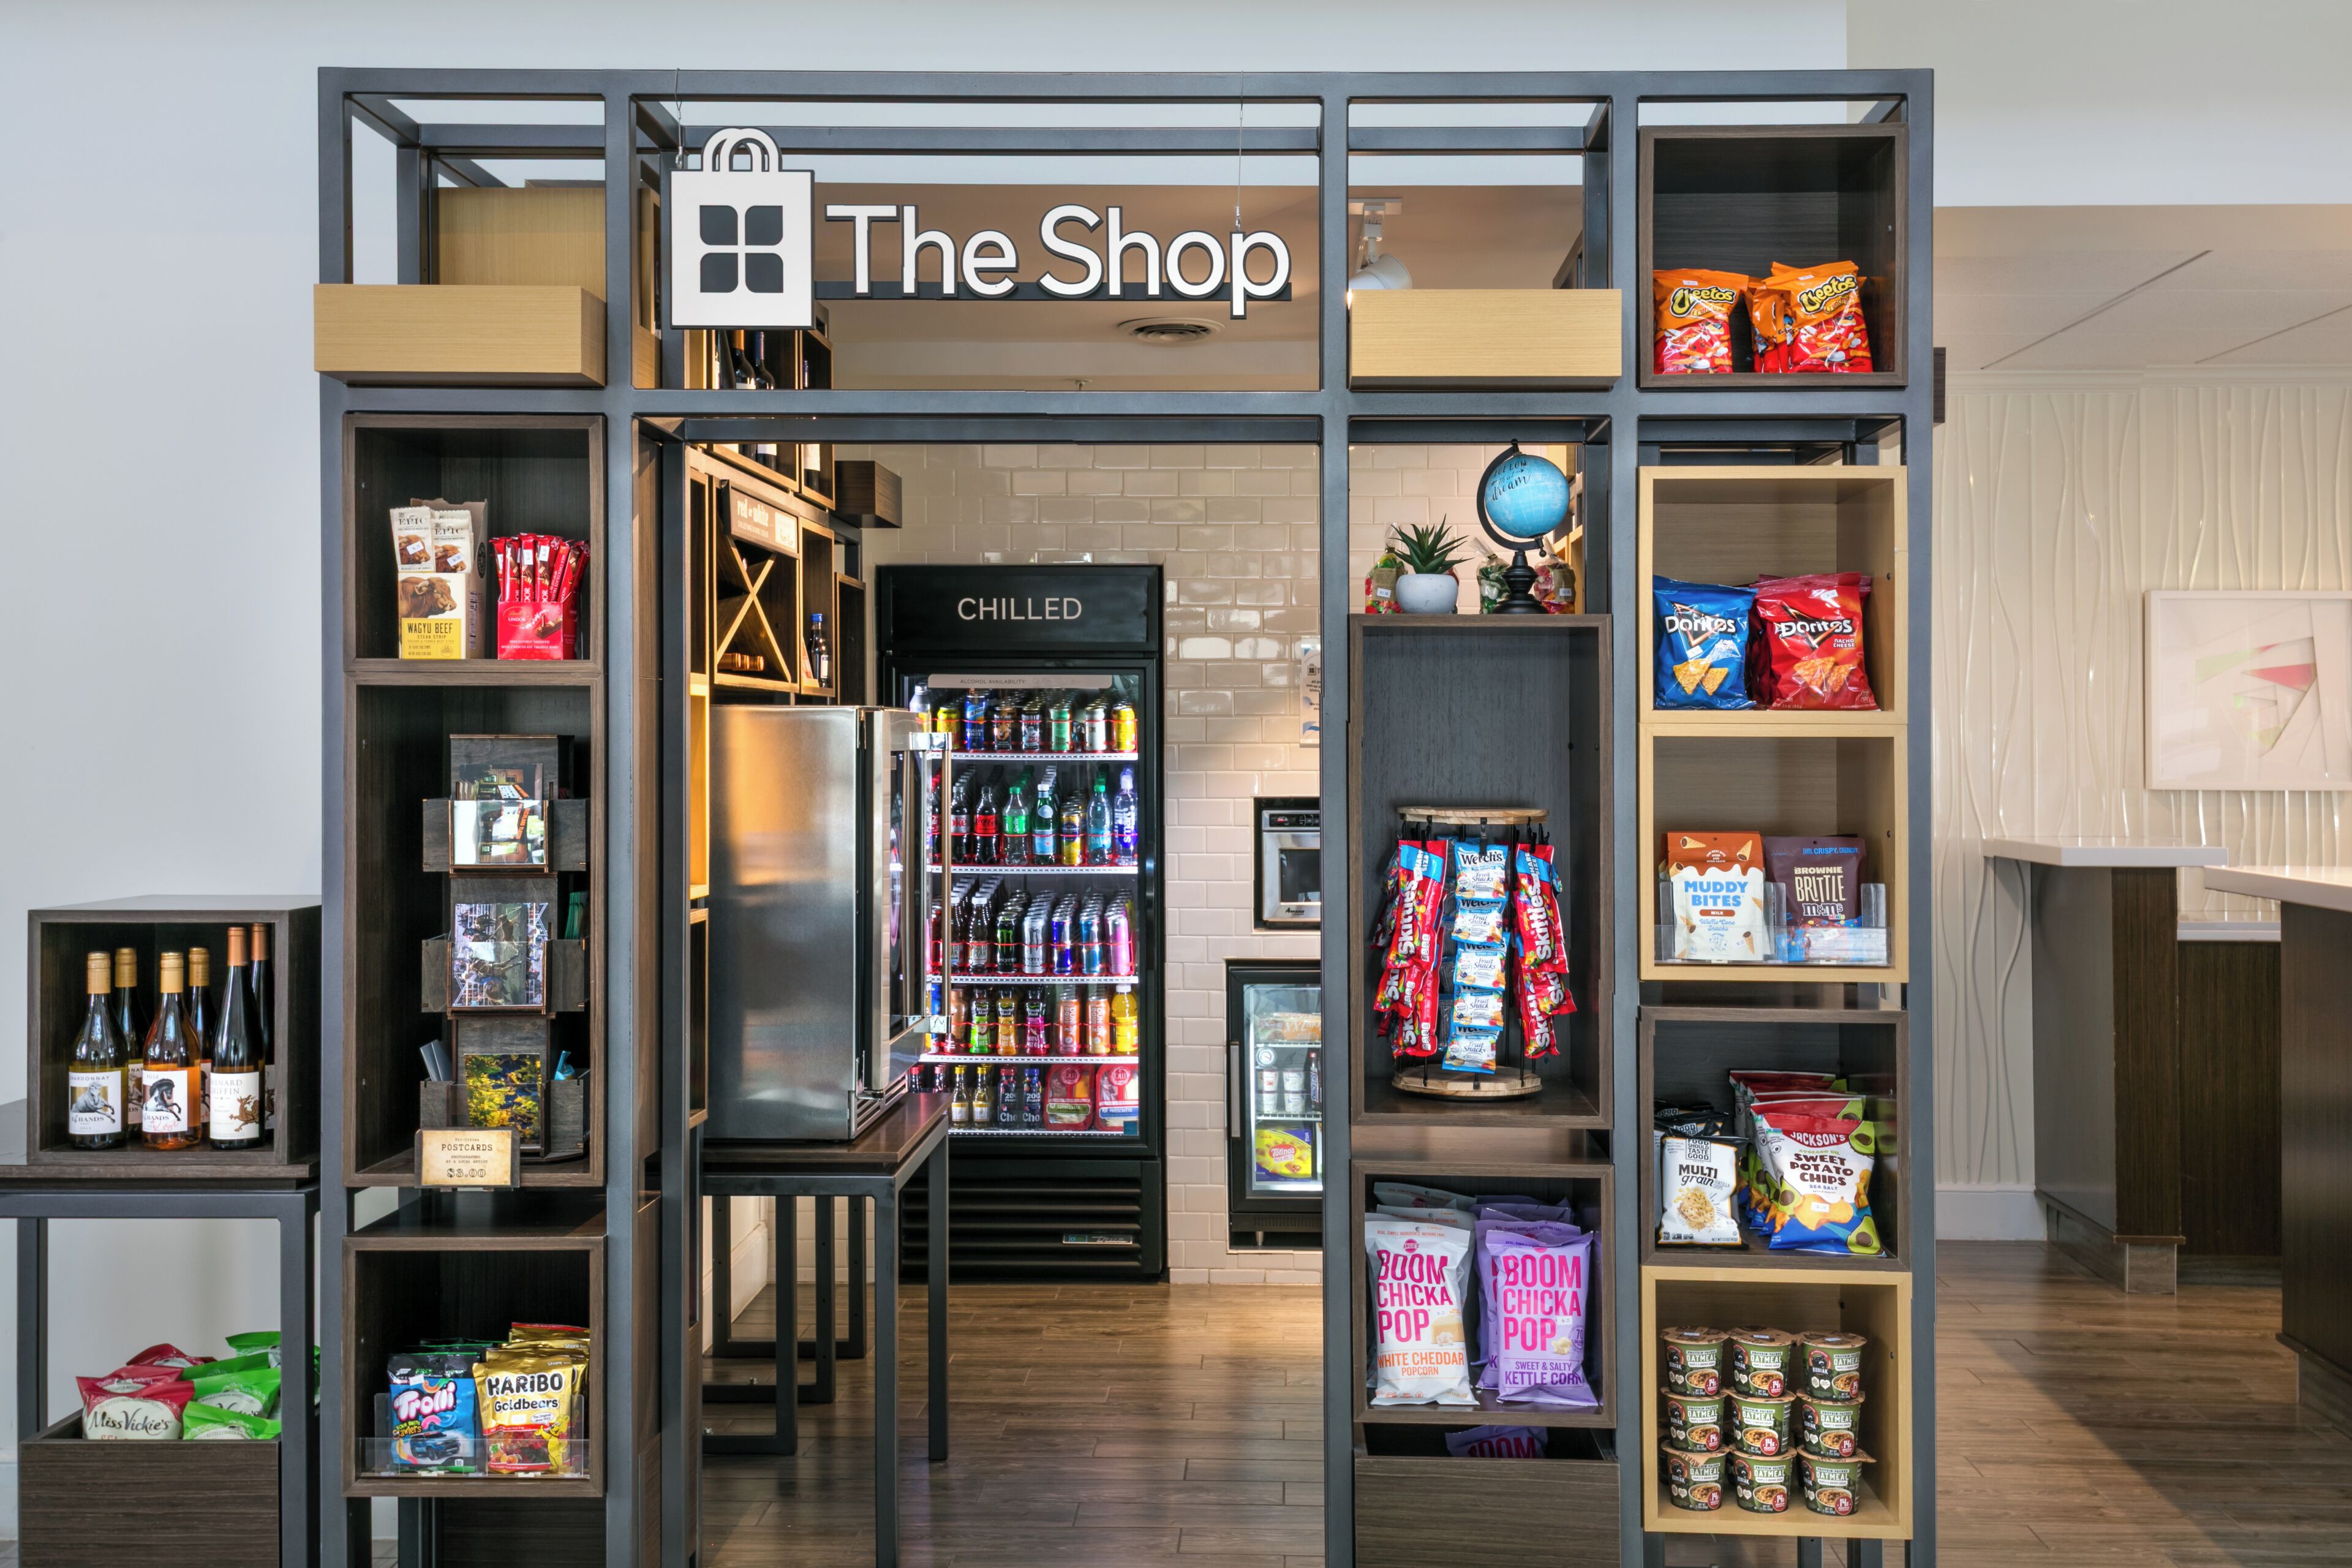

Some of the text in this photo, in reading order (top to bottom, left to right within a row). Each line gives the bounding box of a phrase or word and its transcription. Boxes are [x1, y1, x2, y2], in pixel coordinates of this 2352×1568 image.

[824, 203, 1292, 320] The Shop
[1672, 287, 1736, 317] Cheetos
[1800, 274, 1858, 314] Cheetos
[1823, 294, 1852, 314] Crunchy
[1492, 475, 1531, 500] dream
[737, 498, 769, 527] red white
[957, 597, 1082, 620] CHILLED
[407, 622, 453, 633] WAGYU BEEF
[1665, 615, 1736, 635] Doritos
[1780, 619, 1854, 638] Doritos
[951, 817, 967, 826] oke
[1415, 849, 1425, 869] HARE
[1794, 866, 1843, 875] BROWNIE
[1684, 881, 1749, 893] MUDDY
[1795, 875, 1845, 903] BRITTLE
[1692, 894, 1741, 907] BITES
[1528, 884, 1553, 960] Skittles
[1790, 1131, 1846, 1147] JACKSON'S
[1271, 1148, 1295, 1157] Totino's
[1794, 1153, 1846, 1166] SWEET
[447, 1167, 486, 1178] $3.00
[1679, 1164, 1718, 1180] MULTI
[1790, 1161, 1854, 1177] POTATO
[1681, 1175, 1714, 1187] grain
[1800, 1172, 1847, 1186] CHIPS
[1376, 1250, 1449, 1286] BOOM
[1502, 1254, 1581, 1289] BOOM
[1377, 1284, 1454, 1308] CHICKA
[1504, 1289, 1581, 1317] CHICKA
[1378, 1308, 1430, 1344] POP
[1504, 1316, 1557, 1352] POP
[1576, 1329, 1583, 1340] 70
[1378, 1351, 1465, 1369] WHITE CHEDDAR
[1686, 1353, 1716, 1362] OATMEAL
[1751, 1355, 1782, 1363] OATMEAL
[1833, 1356, 1860, 1366] OATMEAL
[1401, 1366, 1439, 1376] POPCORN
[1515, 1361, 1572, 1372] SWEET & SALTY
[486, 1372, 564, 1397] HARIBO
[1505, 1370, 1583, 1386] KETTLE CORN
[393, 1381, 456, 1422] Trolli
[494, 1398, 559, 1412] Goldbears
[88, 1408, 170, 1436] Miss Vickie's
[1742, 1411, 1775, 1421] OATMEAL
[1820, 1414, 1852, 1423] OATMEAL
[1689, 1467, 1720, 1476] OATMEAL
[1815, 1471, 1849, 1481] OATMEAL
